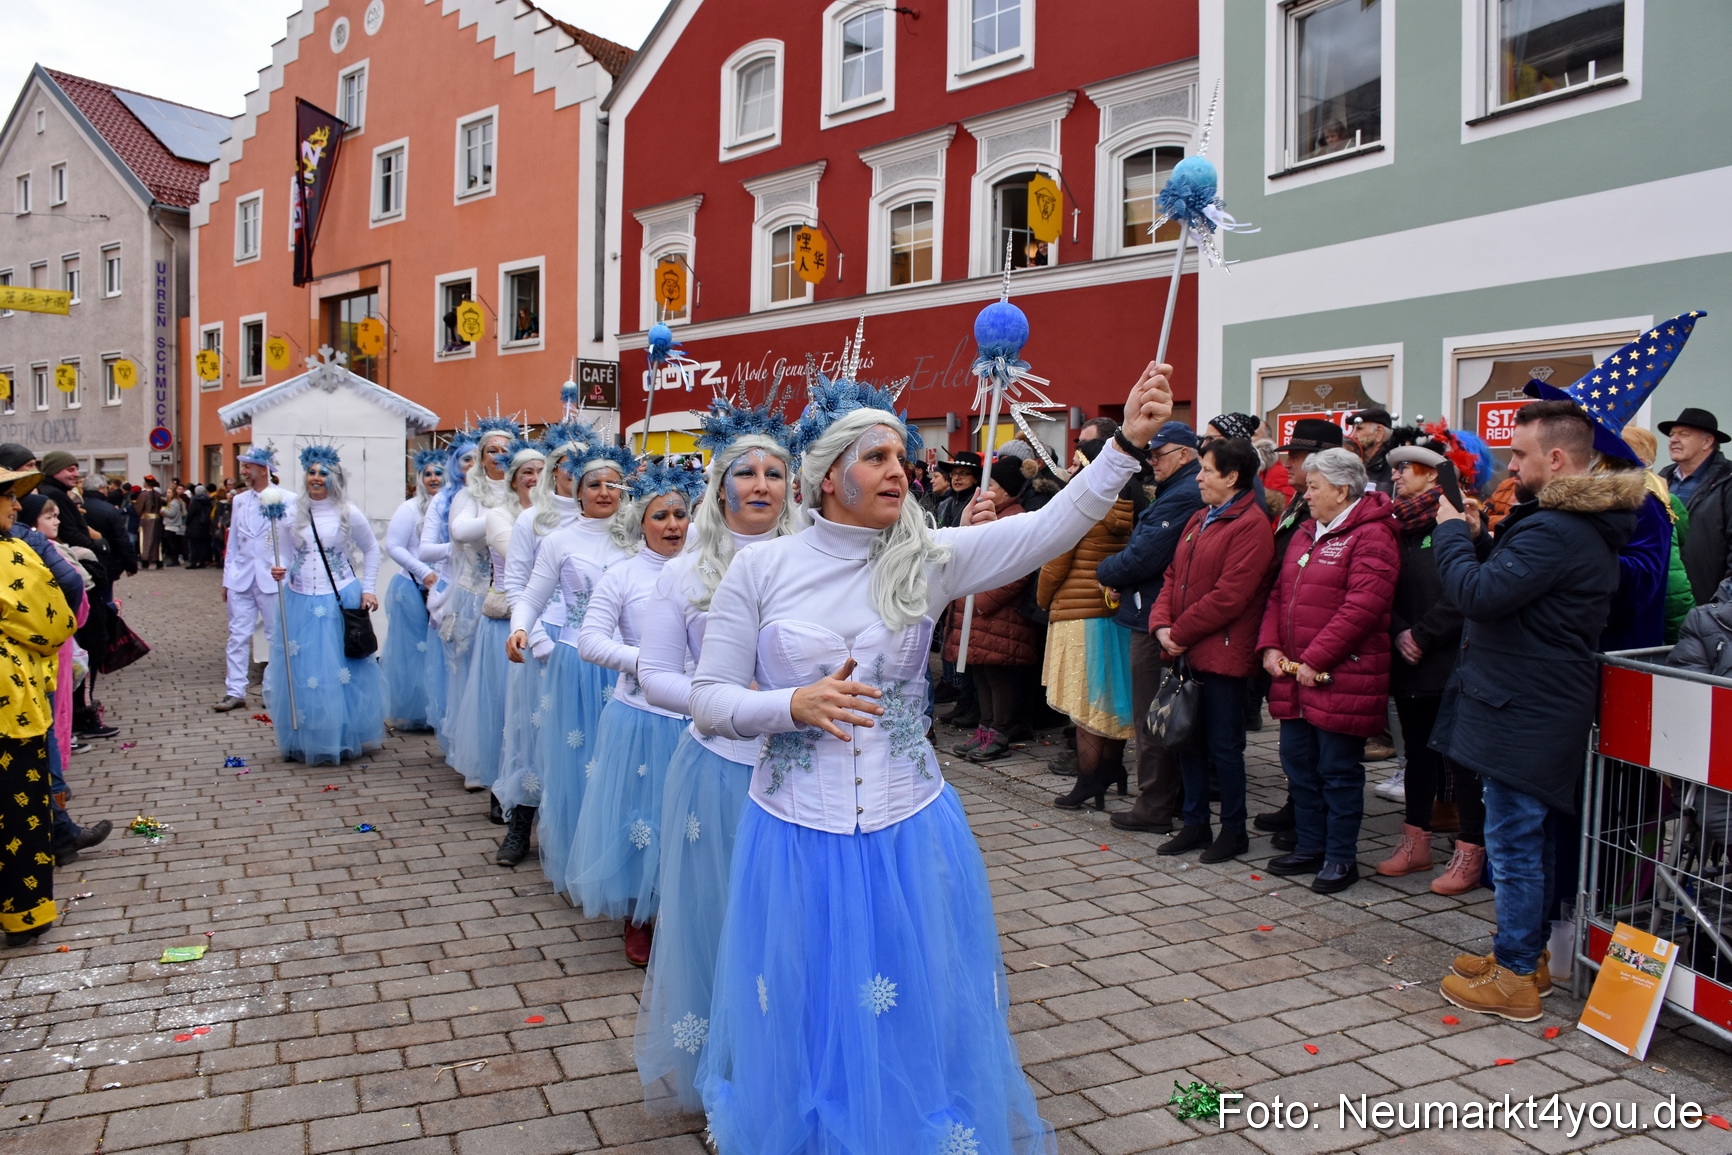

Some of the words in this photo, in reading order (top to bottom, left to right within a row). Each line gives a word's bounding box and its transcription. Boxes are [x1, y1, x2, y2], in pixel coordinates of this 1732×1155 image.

[157, 262, 167, 328] UHREN
[156, 337, 167, 427] SCHMUCK
[582, 366, 614, 384] CAFÉ
[731, 350, 773, 385] Mode
